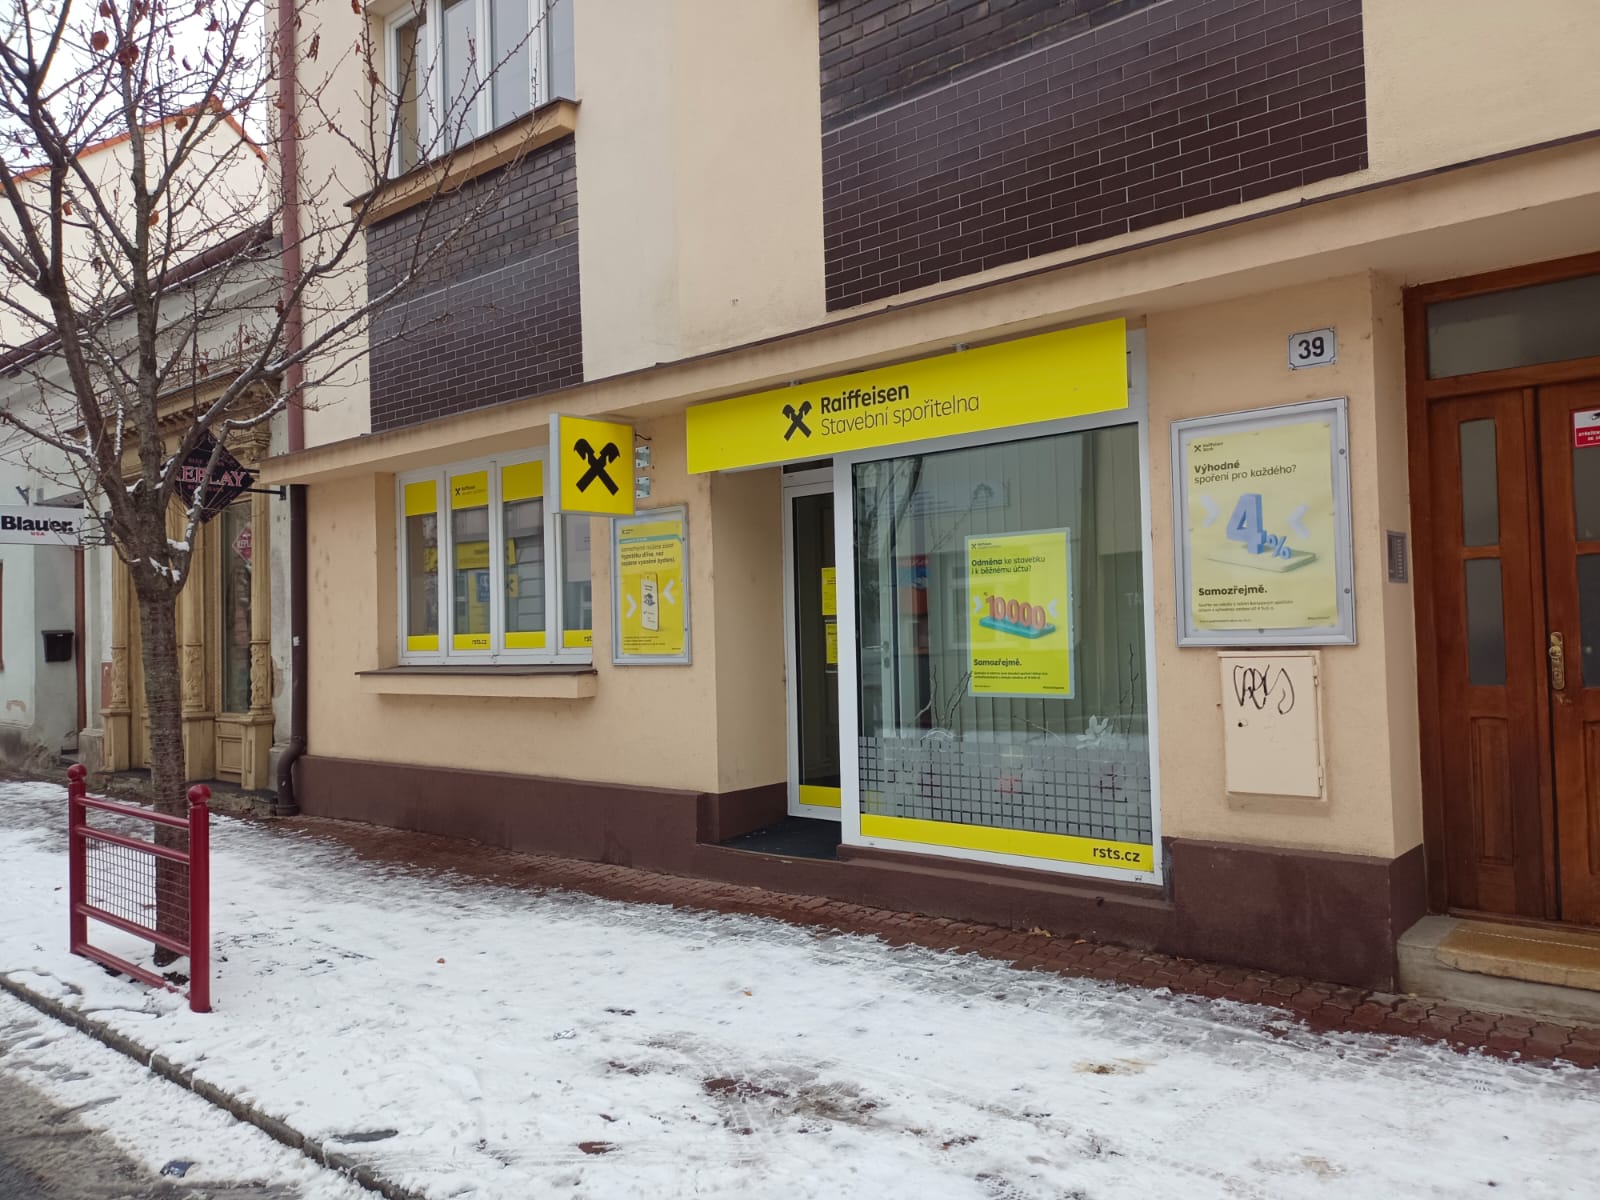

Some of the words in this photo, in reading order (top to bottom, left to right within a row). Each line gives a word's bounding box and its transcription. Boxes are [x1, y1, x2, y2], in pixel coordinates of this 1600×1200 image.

[1298, 336, 1325, 360] 39
[820, 384, 910, 414] Raiffeisen
[821, 406, 889, 436] Stavební
[893, 394, 981, 427] spořitelna
[176, 466, 246, 487] EPLAY
[1194, 459, 1240, 475] Výhodné
[1194, 472, 1229, 485] spoření
[1231, 471, 1248, 482] pro
[1250, 464, 1297, 478] každého?
[1226, 493, 1293, 560] 4%
[971, 557, 1003, 567] Odměna
[1198, 584, 1268, 597] Samozřejmě.
[974, 658, 1023, 667] Samozřejmě.
[1093, 847, 1141, 863] rsts.cz
